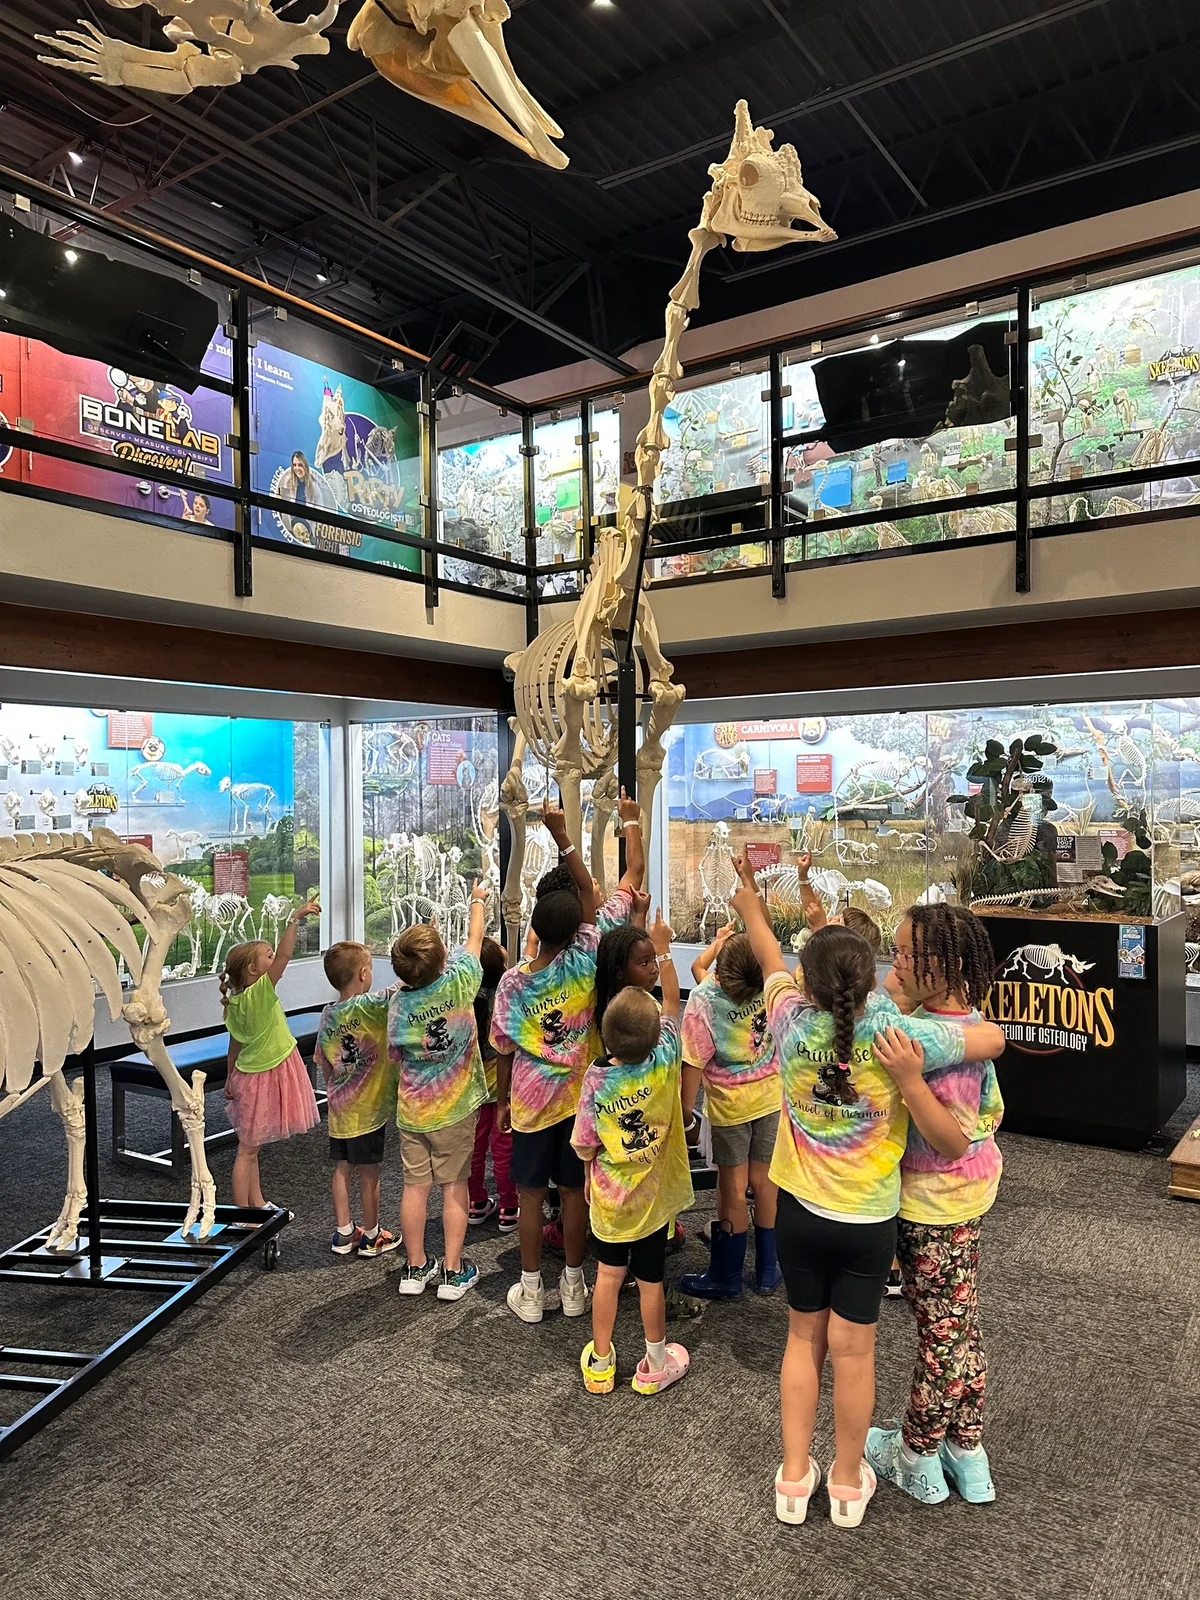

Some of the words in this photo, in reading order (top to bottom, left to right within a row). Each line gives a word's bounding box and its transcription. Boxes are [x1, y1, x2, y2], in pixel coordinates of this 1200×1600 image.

[263, 360, 294, 381] learn.
[83, 399, 219, 455] BONELAB
[88, 424, 126, 439] OBSERVE
[133, 437, 171, 452] MEASURE
[177, 449, 214, 463] CLASSIFY
[344, 470, 405, 509] PARTY
[315, 522, 363, 548] FORENSIC
[315, 539, 339, 555] NIGHT
[431, 733, 451, 743] CATS
[740, 723, 796, 735] CARNIVORA
[407, 999, 456, 1027] Primrose
[521, 991, 570, 1018] Primrose
[980, 980, 1116, 1048] KELETONS
[999, 1023, 1024, 1041] SEUM
[1025, 1025, 1037, 1042] OF
[1039, 1027, 1088, 1052] OSTEOLOGY
[795, 1041, 875, 1064] Primse
[594, 1086, 653, 1120] Primrose
[789, 1096, 820, 1116] School
[824, 1107, 837, 1123] of
[841, 1110, 889, 1120] Norman
